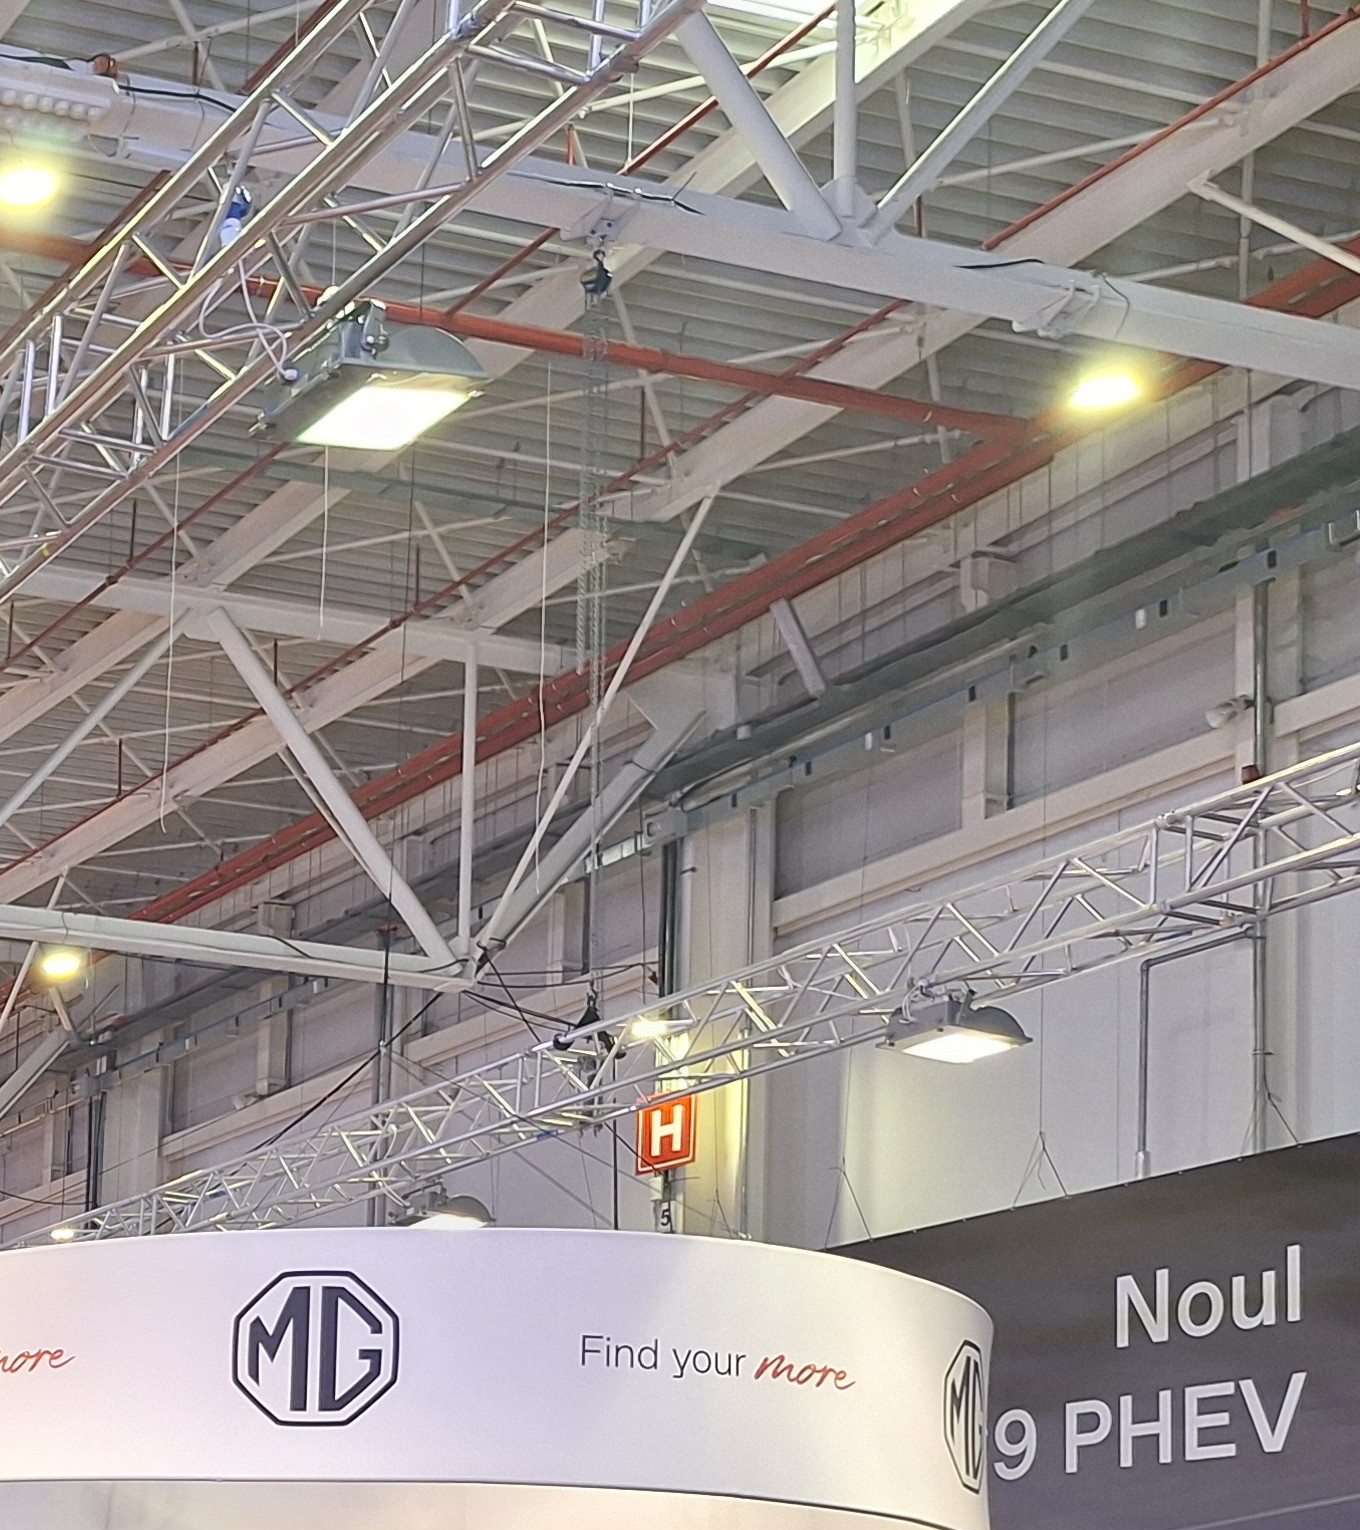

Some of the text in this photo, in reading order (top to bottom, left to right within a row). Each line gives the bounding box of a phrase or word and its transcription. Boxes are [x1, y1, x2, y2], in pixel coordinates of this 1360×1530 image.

[651, 1105, 684, 1157] H
[1115, 1245, 1302, 1347] Noul
[246, 1284, 384, 1413] MG
[581, 1334, 857, 1390] Find your more
[1064, 1372, 1308, 1474] PHEV
